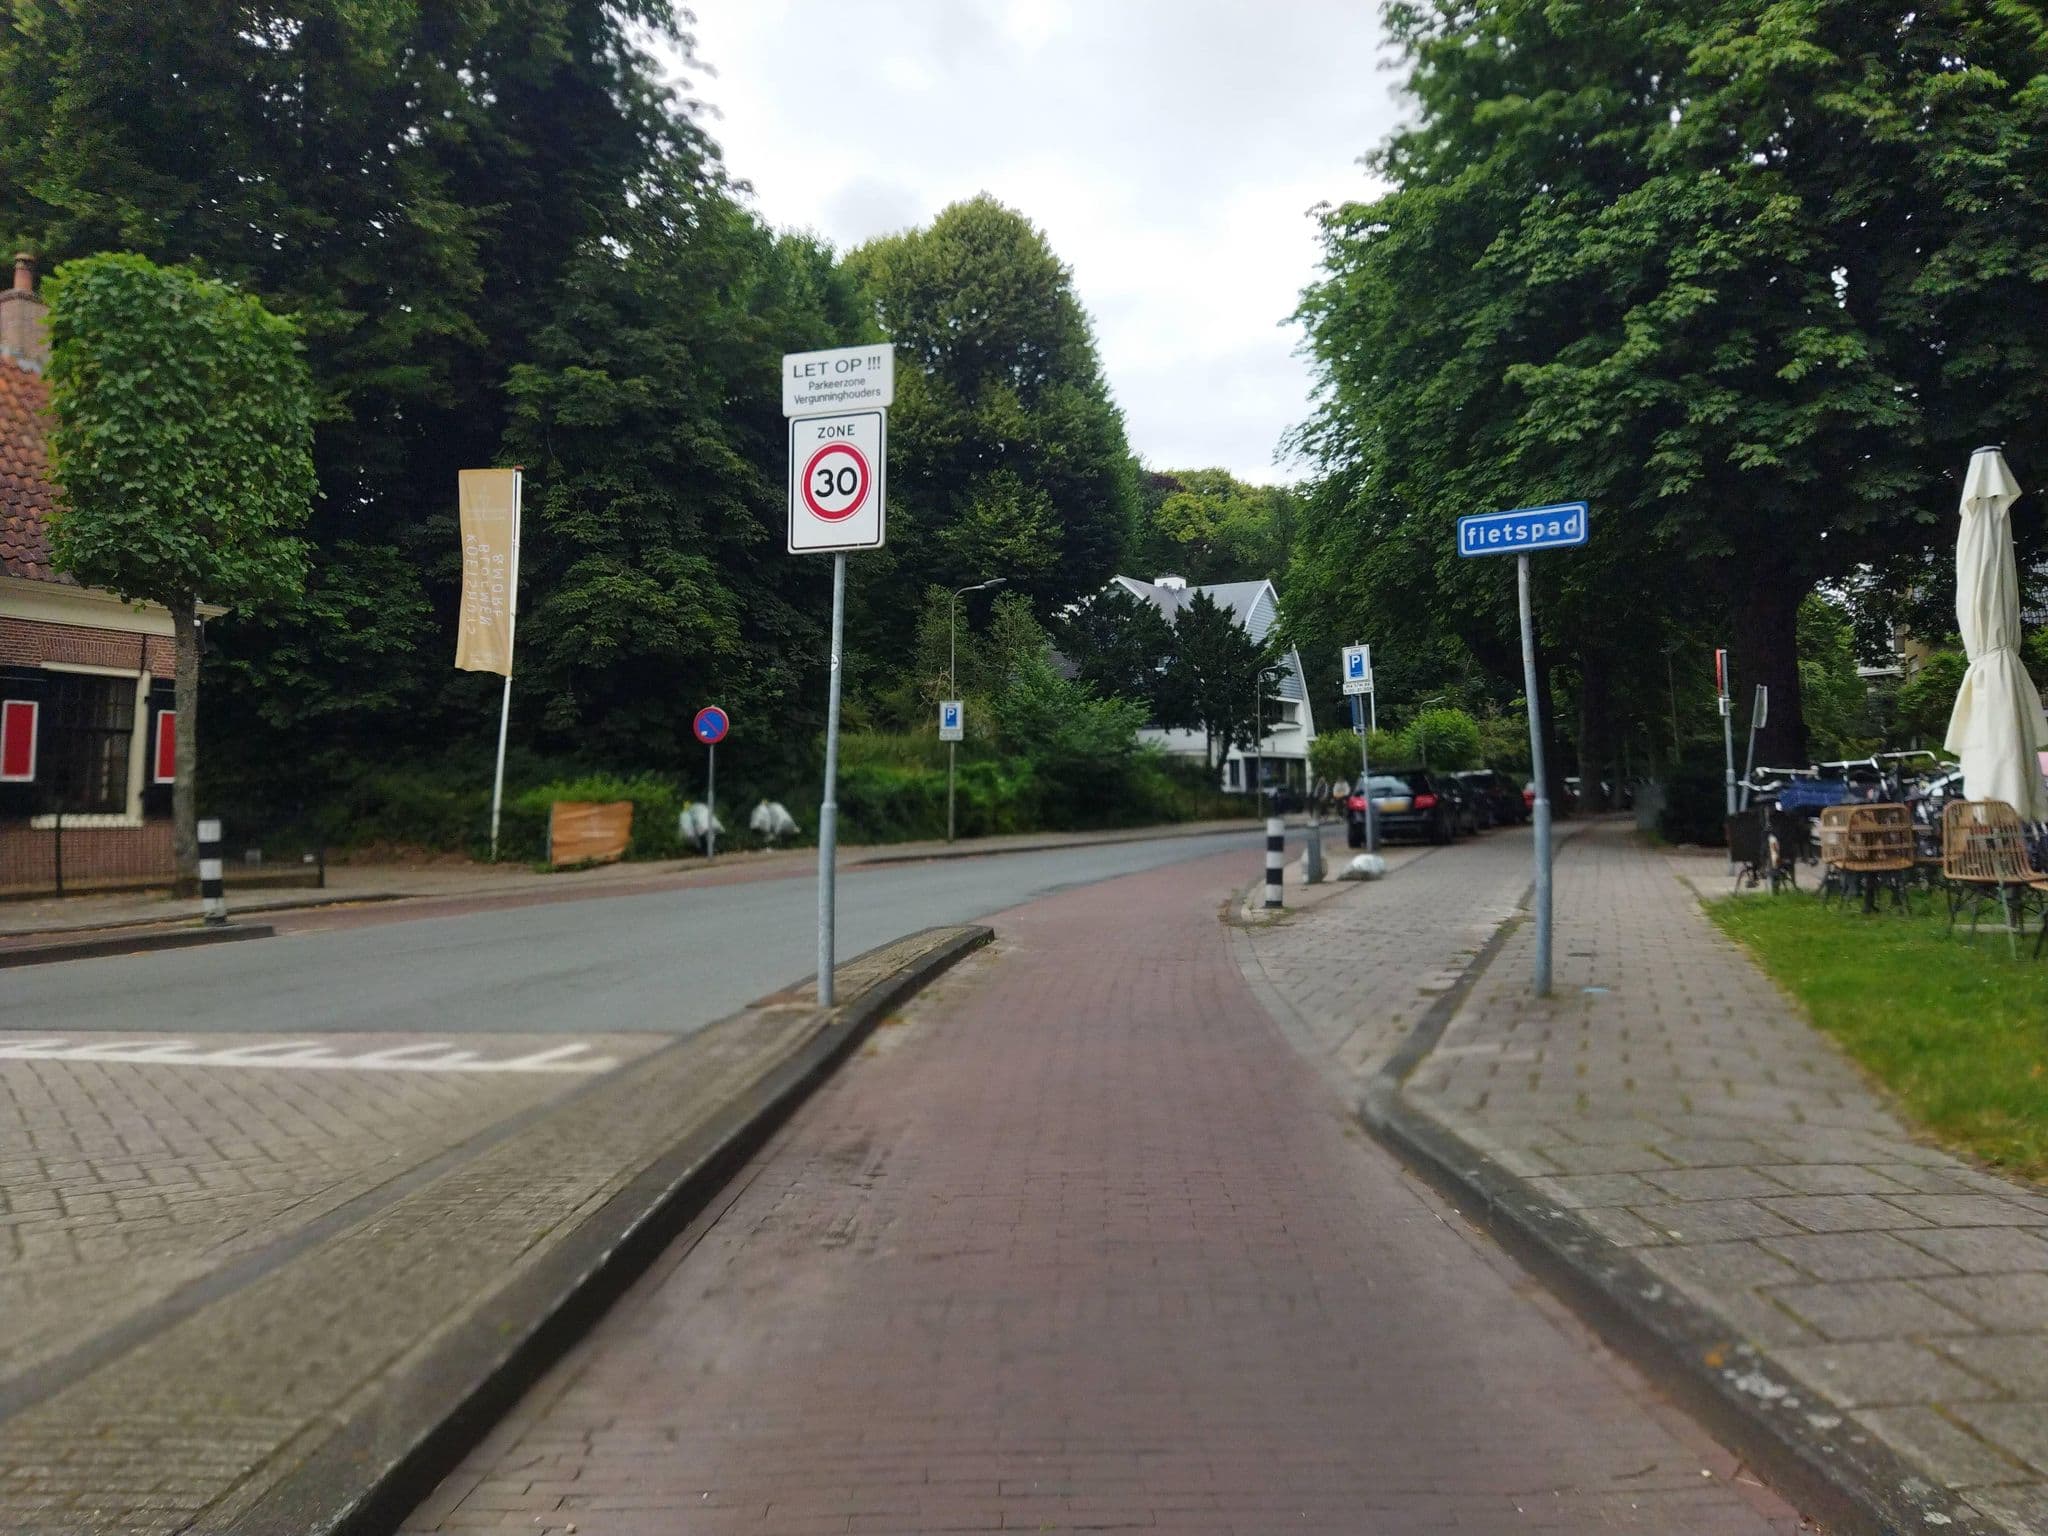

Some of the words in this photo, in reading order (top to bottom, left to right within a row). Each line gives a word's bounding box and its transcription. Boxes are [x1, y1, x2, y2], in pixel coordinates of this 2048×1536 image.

[793, 361, 829, 378] LET
[835, 358, 861, 374] OP
[868, 356, 881, 371] !!!
[808, 377, 866, 391] Parkeerzone
[794, 387, 881, 405] Vergunninghouders
[817, 424, 856, 439] ZONE
[815, 466, 858, 498] 30
[1467, 514, 1578, 545] fietspad
[1351, 655, 1361, 668] P
[947, 708, 955, 720] P
